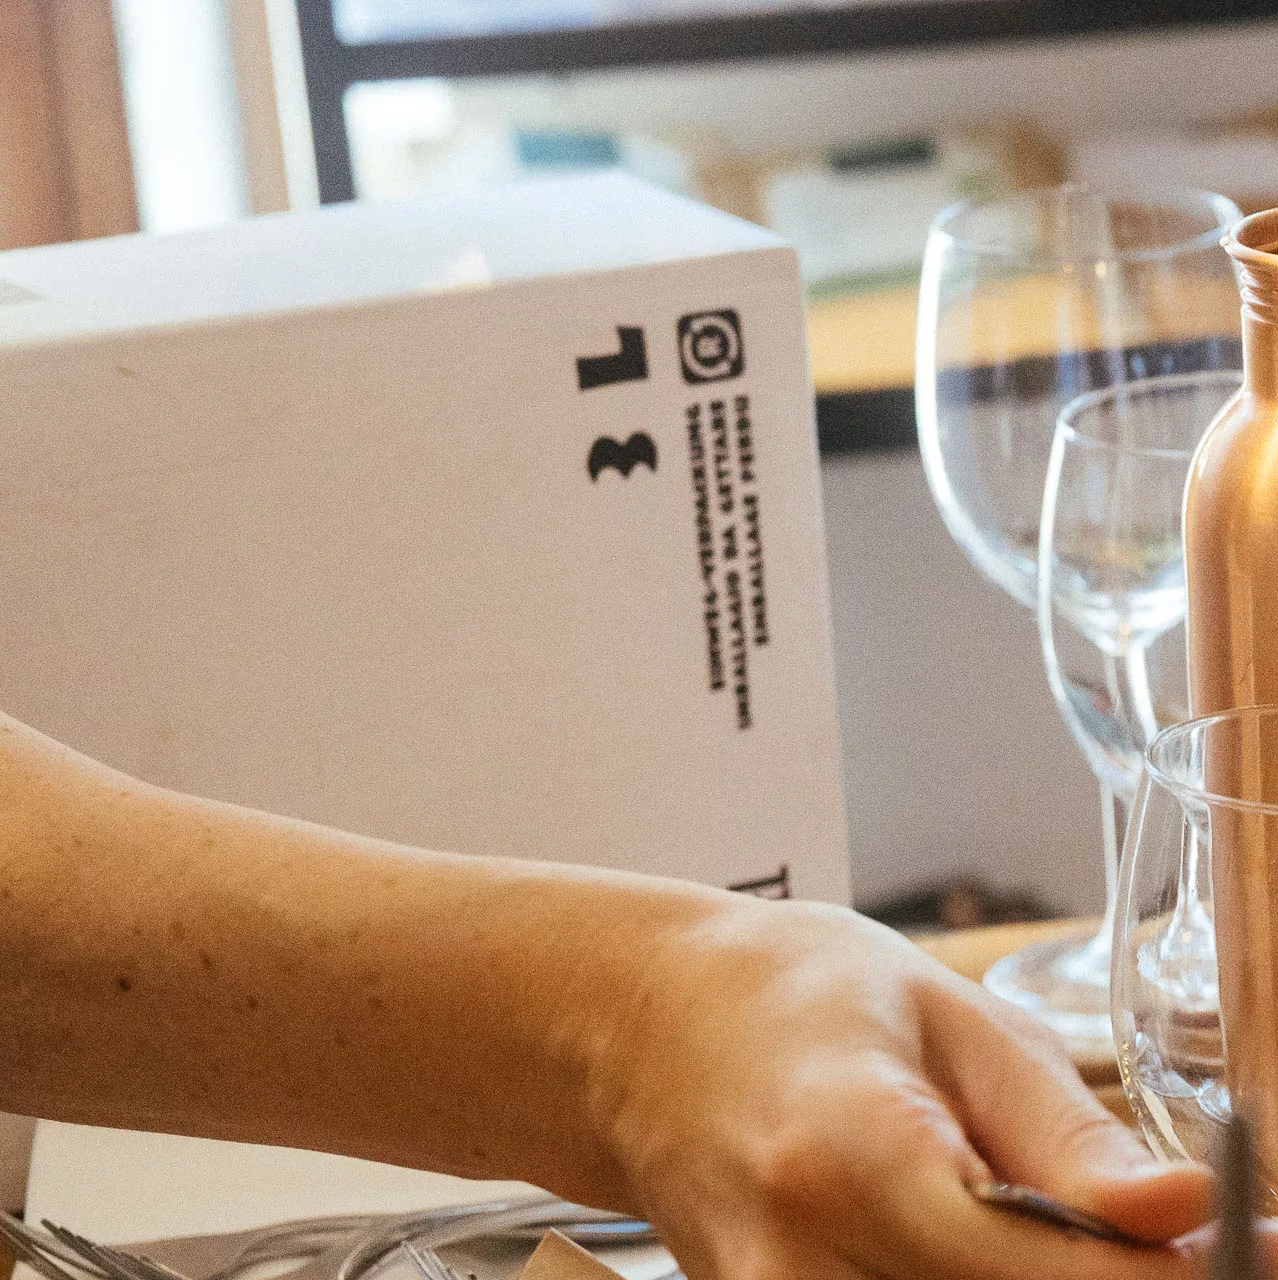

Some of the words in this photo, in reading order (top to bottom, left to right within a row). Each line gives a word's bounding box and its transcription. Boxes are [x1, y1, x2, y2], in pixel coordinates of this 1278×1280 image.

[576, 326, 650, 391] L
[587, 431, 657, 484] 3
[710, 400, 734, 512] GETTARE
[735, 394, 756, 481] PERDU
[722, 526, 739, 560] DA
[743, 495, 769, 646] EMBALLAGE
